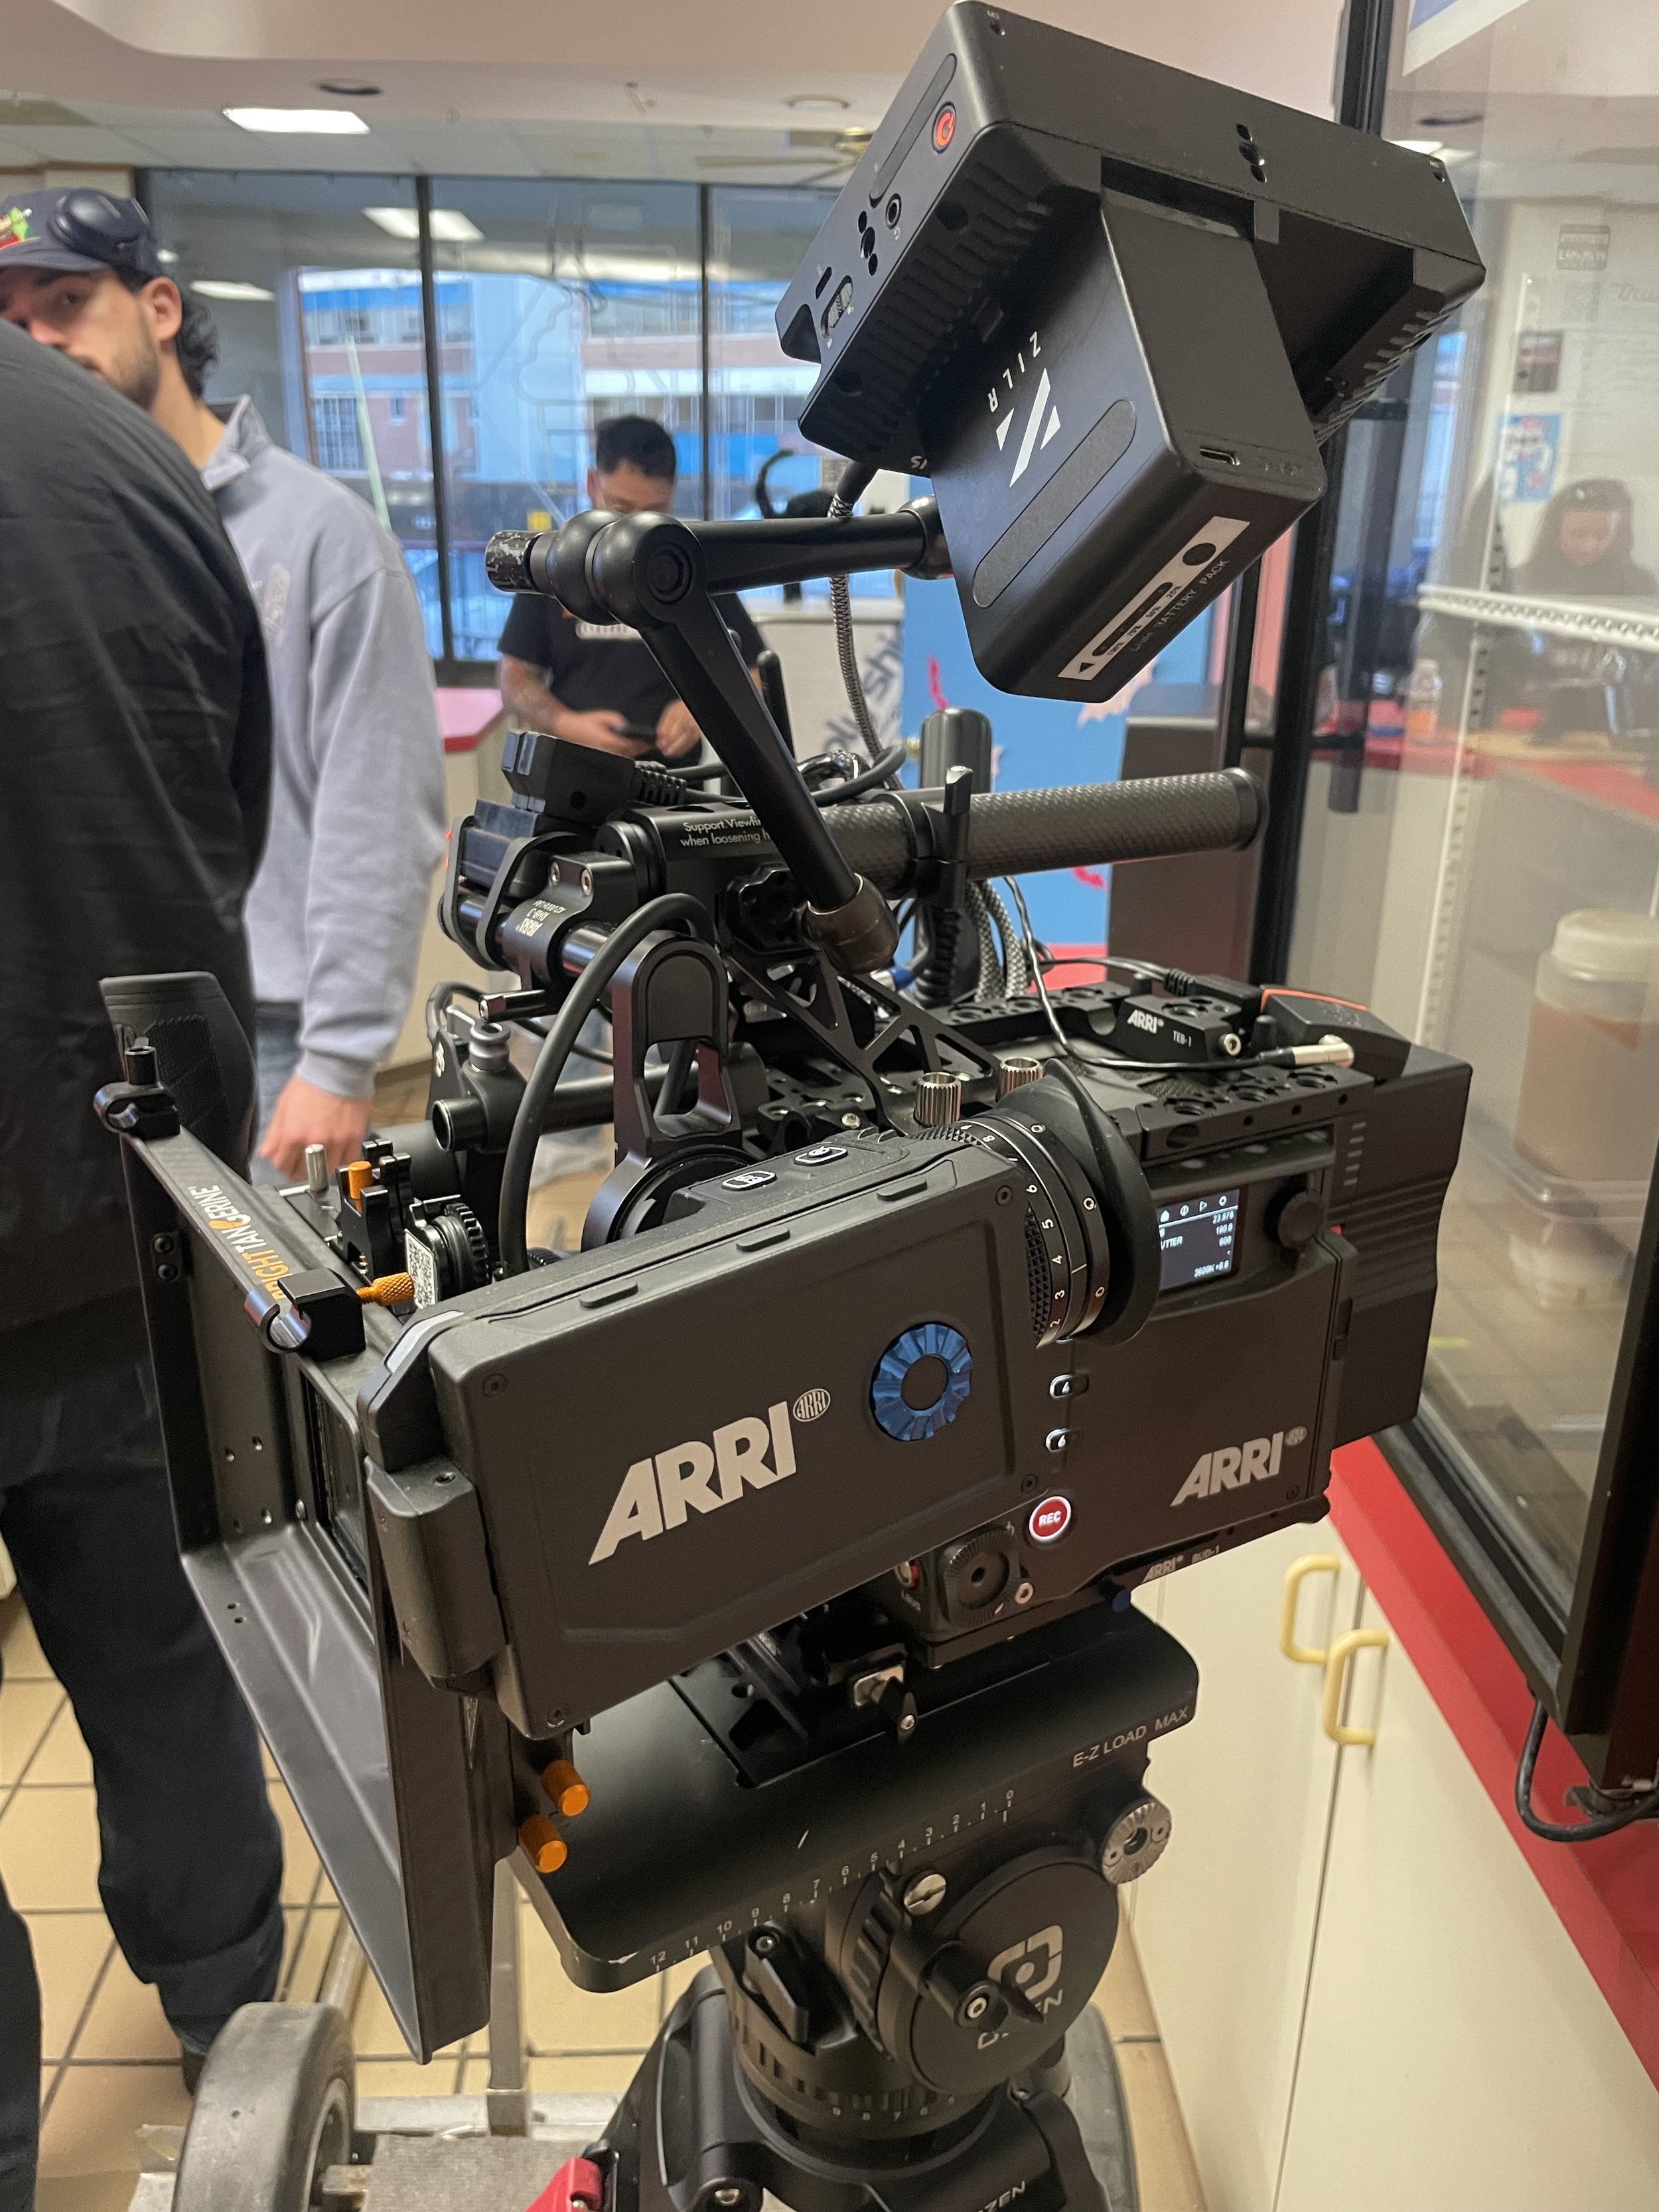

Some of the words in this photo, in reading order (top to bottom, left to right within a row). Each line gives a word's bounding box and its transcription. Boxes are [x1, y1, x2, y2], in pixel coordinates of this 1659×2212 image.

[987, 331, 1041, 412] ZILR
[1154, 589, 1196, 628] BATTERY
[1199, 559, 1230, 584] PACK
[680, 834, 709, 847] when
[711, 831, 761, 845] loosening
[683, 820, 725, 834] Support
[1127, 1009, 1157, 1034] ARRI
[1042, 1218, 1054, 1228] 5
[1052, 1255, 1062, 1264] 4
[1054, 1290, 1065, 1299] 3
[1050, 1319, 1060, 1328] 2
[1170, 1431, 1284, 1507] ARRI
[589, 1400, 796, 1566] ARRI
[1039, 1511, 1062, 1527] REC
[1142, 1557, 1176, 1584] ARRI
[1073, 1744, 1100, 1767] E-Z
[1103, 1725, 1147, 1754] LOAD
[1154, 1706, 1189, 1732] MAX
[650, 1951, 666, 1964] 12
[685, 1936, 698, 1949] 11
[717, 1921, 733, 1933] 10
[751, 1907, 760, 1917] 9
[782, 1893, 791, 1903] 8
[813, 1878, 821, 1889] 7
[841, 1866, 849, 1876] 6
[871, 1852, 879, 1862] 5
[898, 1839, 905, 1848] 4
[926, 1826, 933, 1836] 3
[953, 1814, 960, 1825] 2
[981, 1802, 986, 1811] 1
[1006, 1789, 1014, 1799] 0
